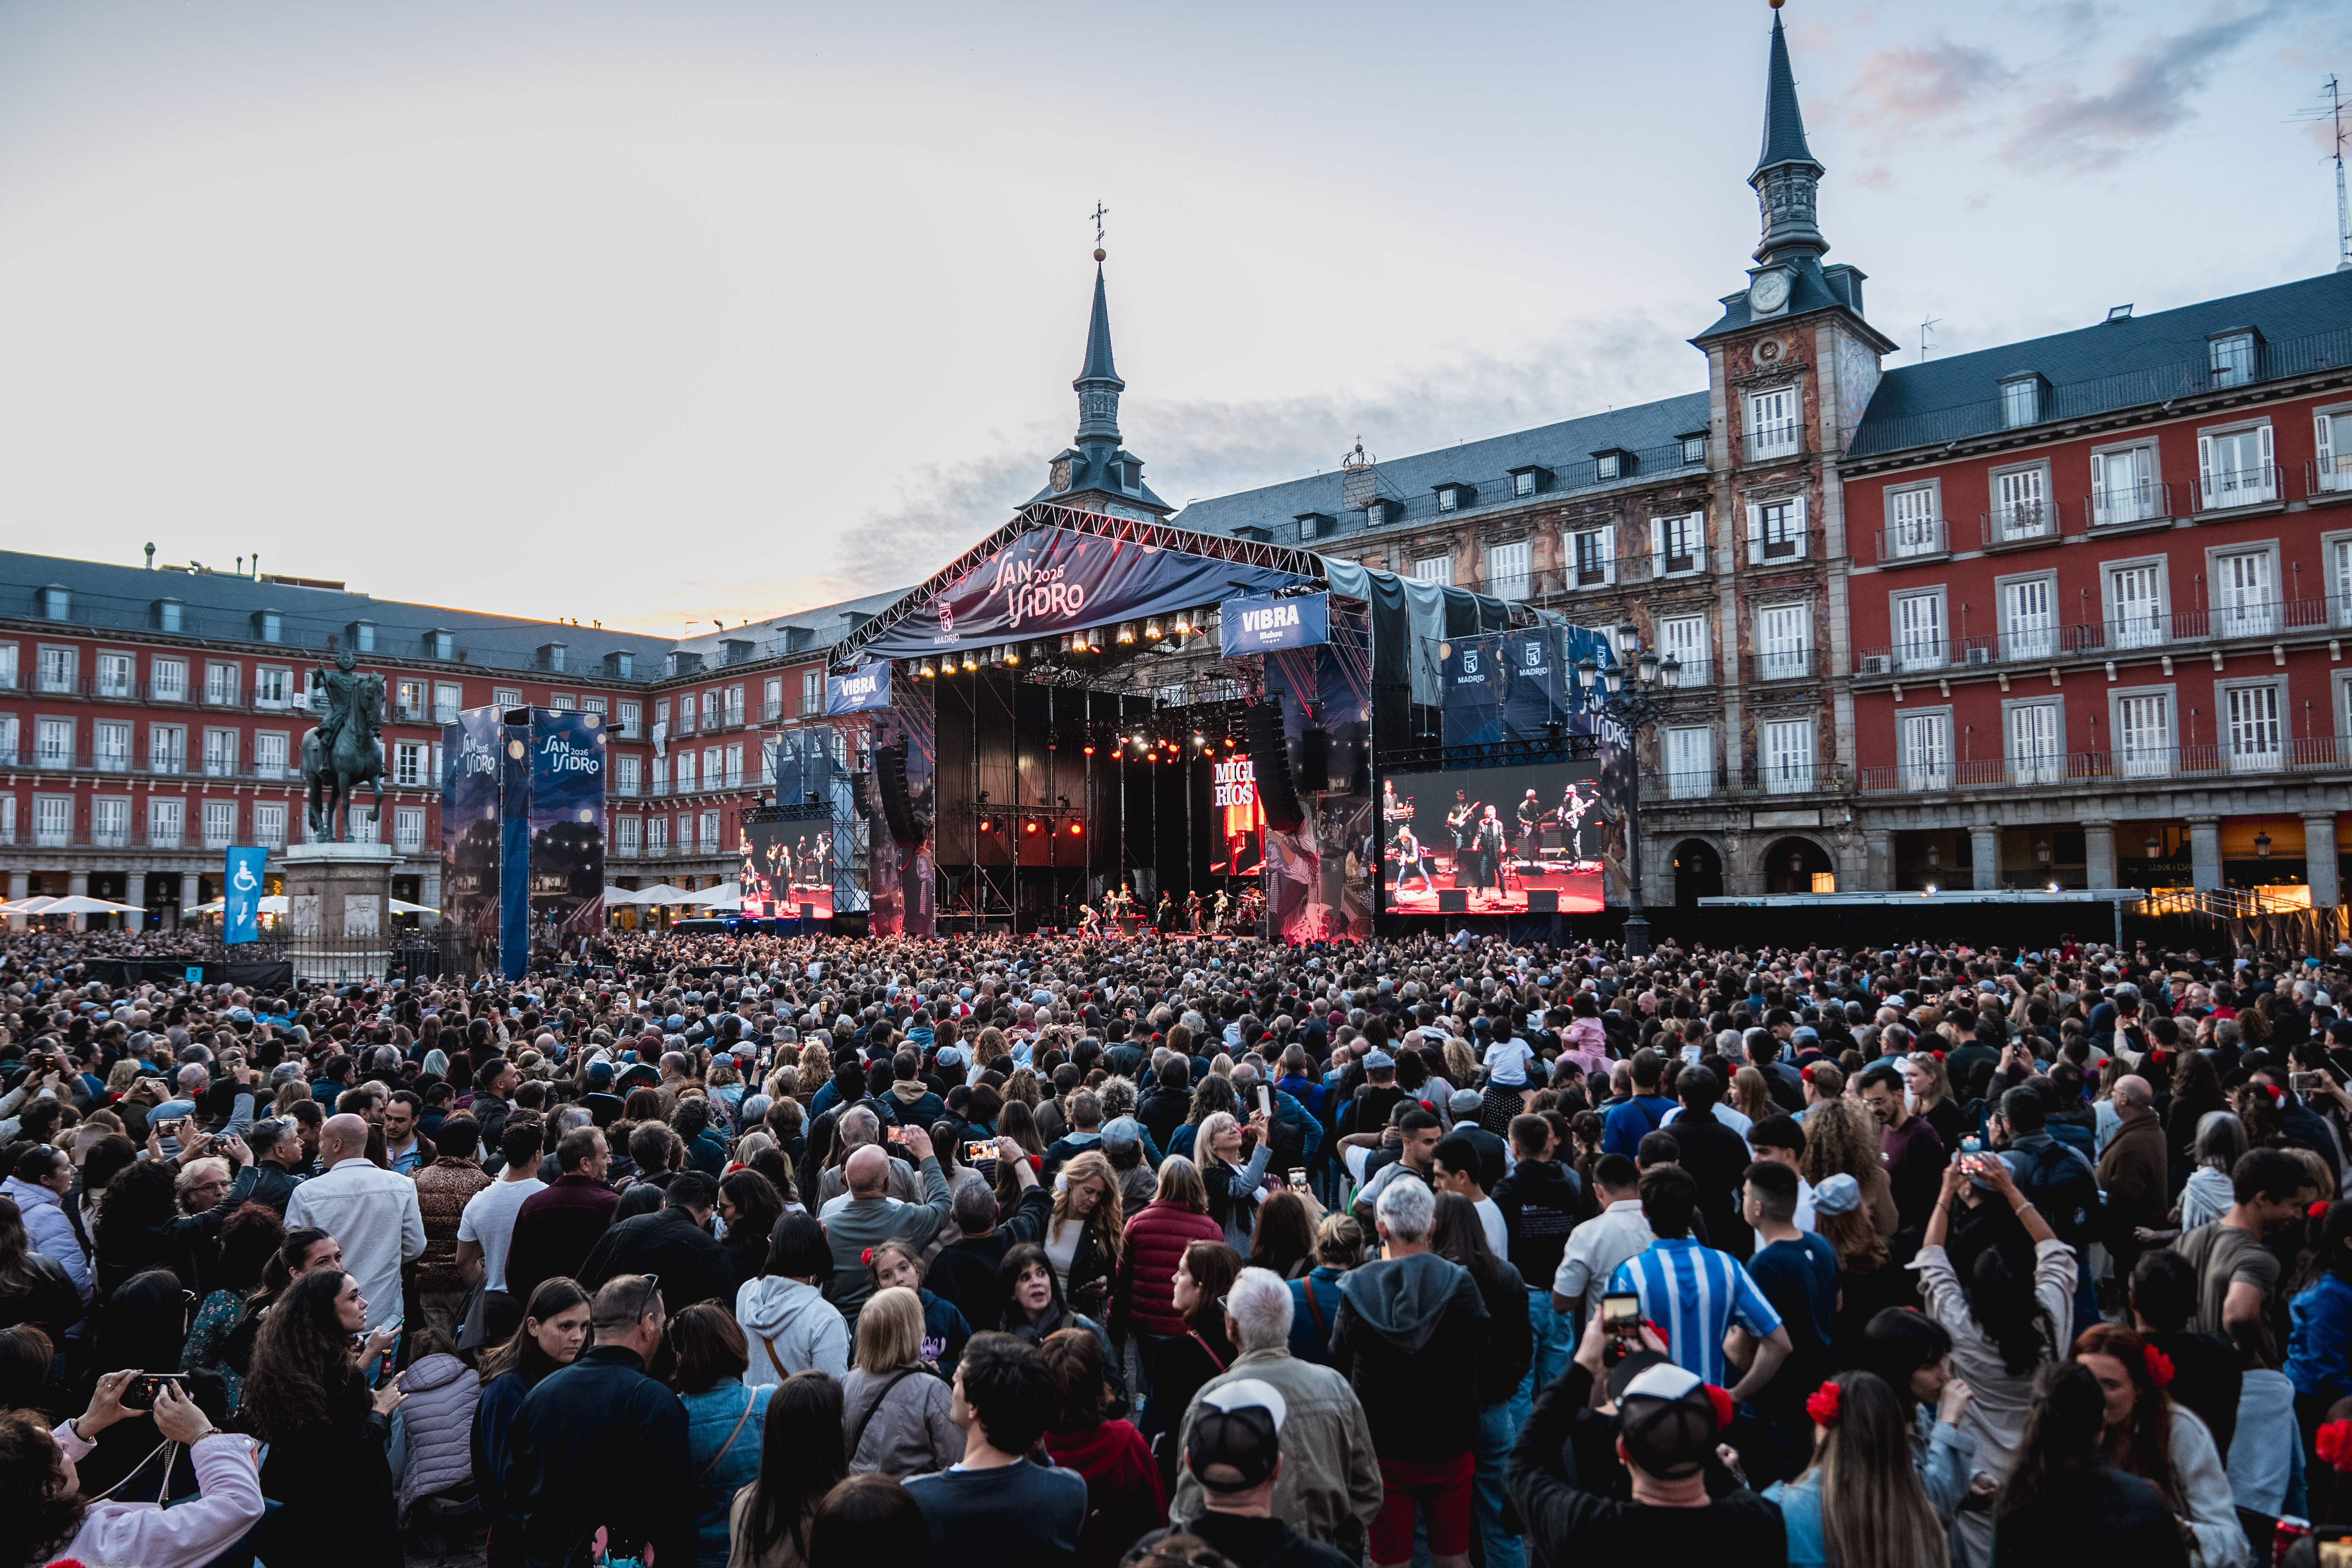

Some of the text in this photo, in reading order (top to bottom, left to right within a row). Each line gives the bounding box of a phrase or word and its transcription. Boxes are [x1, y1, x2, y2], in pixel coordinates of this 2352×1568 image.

[990, 551, 1064, 595] SAN 2026
[1008, 583, 1084, 628] ISIDRO
[1242, 604, 1299, 632] VIBRA
[934, 633, 959, 644] MADRID
[1260, 630, 1283, 640] Mahou
[1458, 675, 1484, 683] MADRID
[1519, 667, 1548, 676] MADRID
[842, 676, 876, 696] VIBRA
[461, 733, 488, 758] SAN 2026
[541, 735, 569, 754] SAN
[467, 753, 495, 777] ISIDRO
[553, 754, 599, 774] ISIDRO
[1215, 783, 1253, 806] RÍOS
